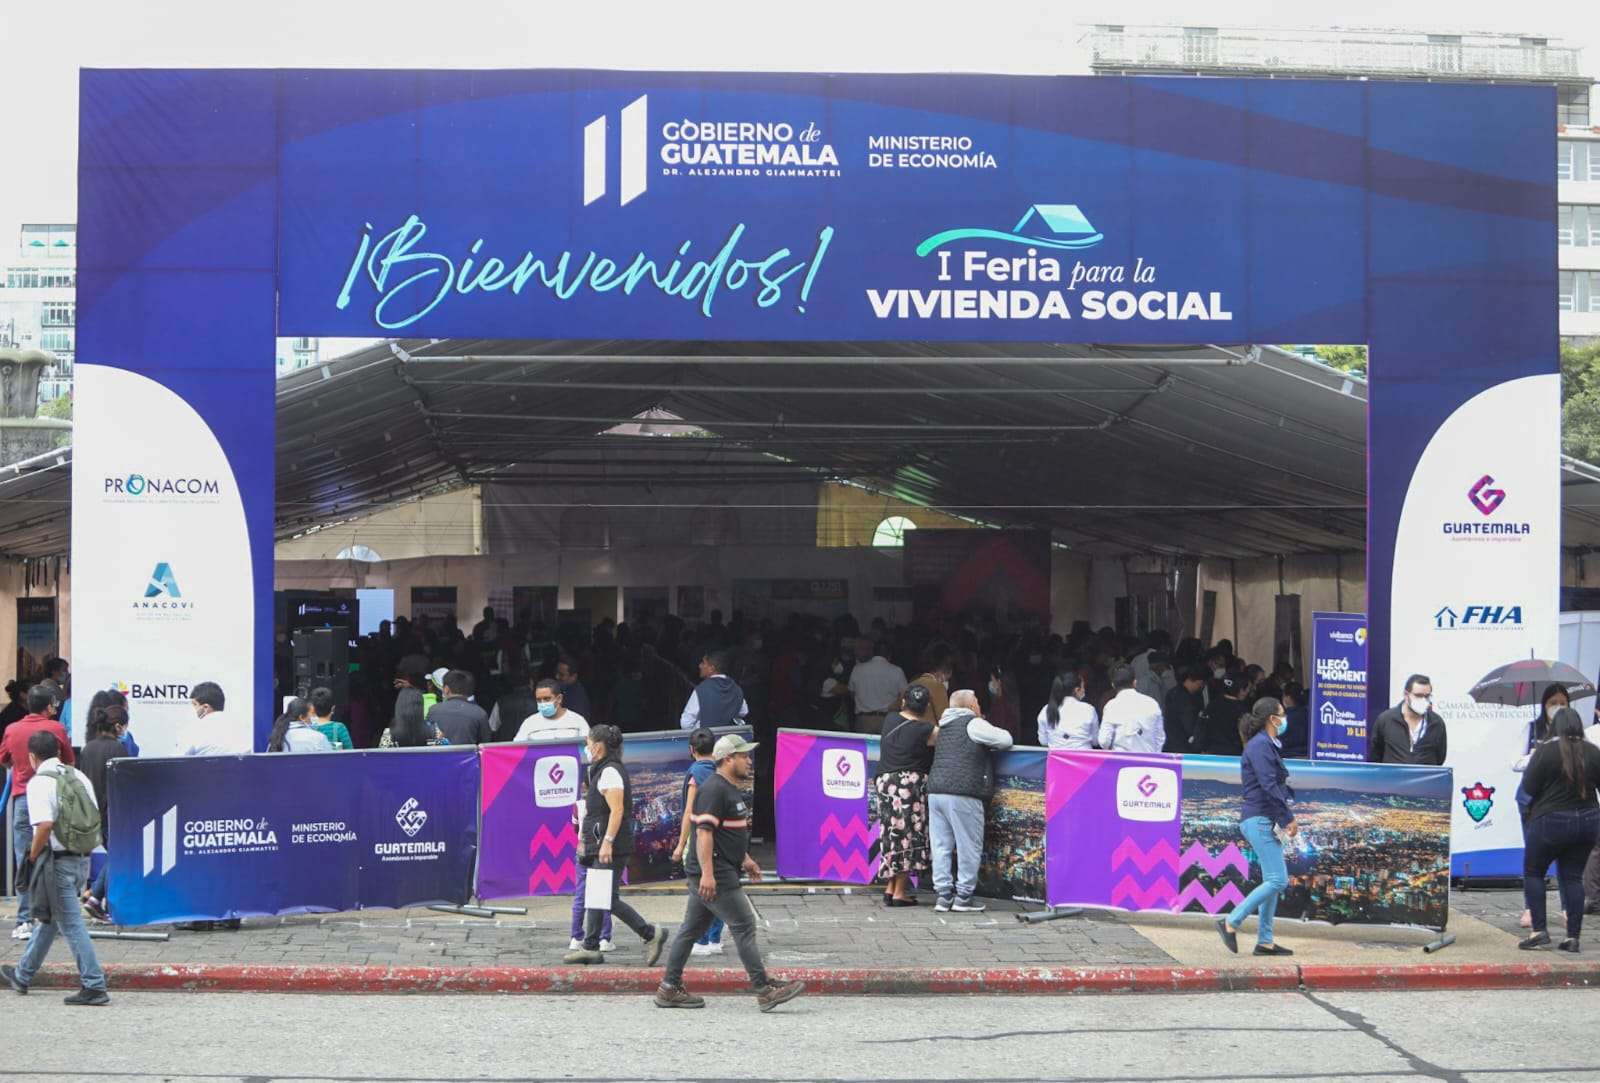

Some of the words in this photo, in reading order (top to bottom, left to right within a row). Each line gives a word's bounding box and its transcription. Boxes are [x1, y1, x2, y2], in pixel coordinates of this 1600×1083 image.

[663, 119, 793, 142] GOBIERNO
[799, 121, 821, 142] de
[869, 135, 972, 151] MINISTERIO
[661, 143, 839, 166] GUATEMALA
[869, 153, 894, 168] DE
[899, 151, 998, 169] ECONOMÍA
[766, 169, 841, 177] GIAMMATTEI
[938, 250, 952, 281] I
[964, 248, 1060, 282] Feria
[1067, 262, 1125, 290] para
[1133, 257, 1156, 284] la
[866, 289, 1072, 319] VIVIENDA
[1081, 290, 1233, 321] SOCIAL
[104, 474, 219, 495] PRONACOM
[1443, 522, 1531, 534] GUATEMALA
[132, 601, 194, 609] ANACOVI
[1461, 606, 1522, 624] FHA
[1317, 657, 1349, 670] LLEGÓ
[1321, 670, 1367, 682] MOMENT
[131, 684, 191, 699] BANTR
[1122, 800, 1171, 809] GUATEMALA
[184, 818, 254, 834] GOBIERNO
[256, 817, 269, 831] de
[291, 822, 346, 833] MINISTERIO
[183, 831, 278, 848] GUATEMALA
[291, 834, 304, 844] DE
[307, 831, 358, 843] ECONOMÍA
[374, 841, 446, 855] GUATEMALA
